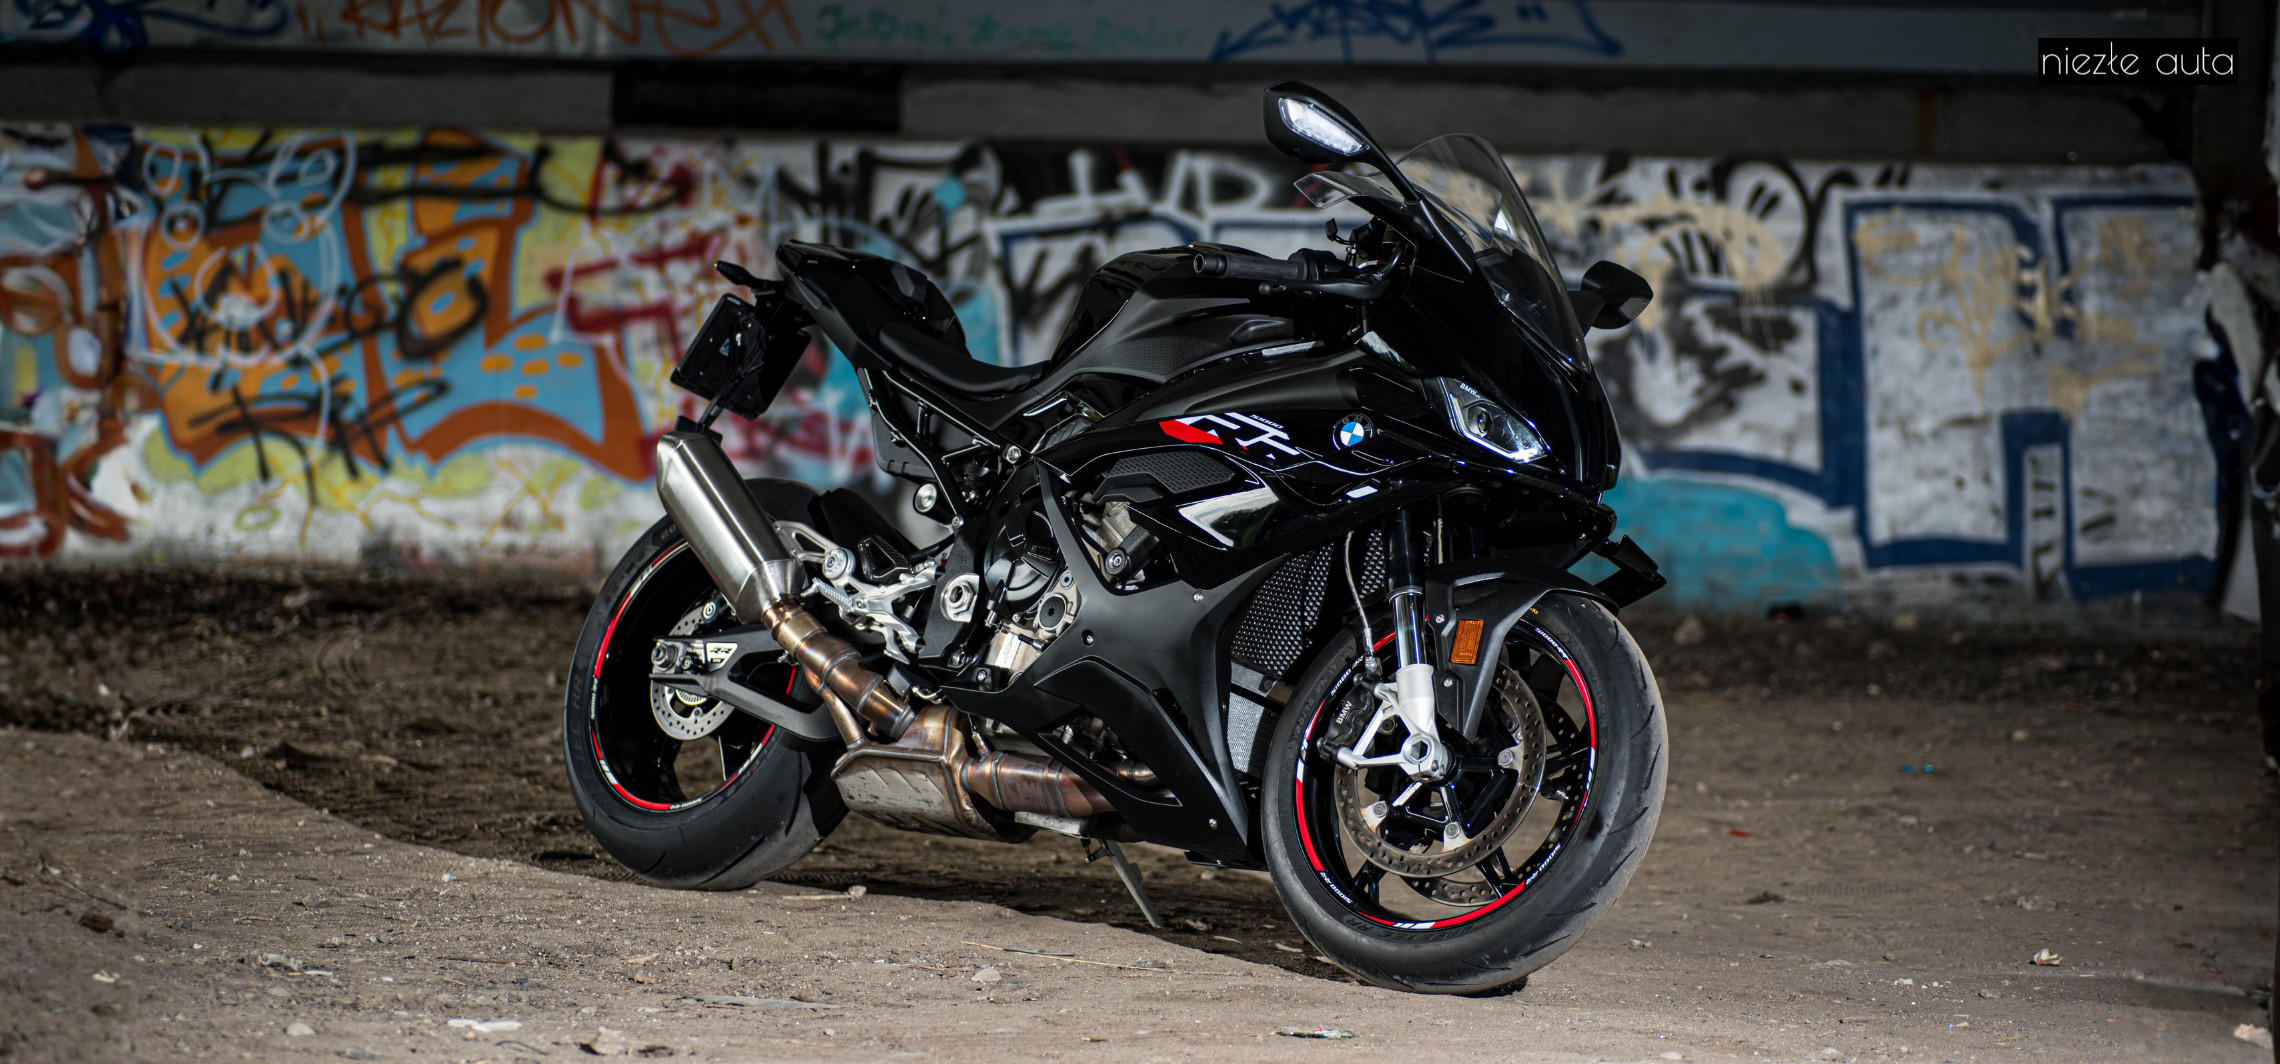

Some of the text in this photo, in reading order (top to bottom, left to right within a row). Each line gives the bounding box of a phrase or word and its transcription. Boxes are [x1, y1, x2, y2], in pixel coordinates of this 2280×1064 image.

[1459, 382, 1477, 396] BMW
[1250, 414, 1284, 429] S1000
[1534, 627, 1557, 647] S1000
[1330, 668, 1352, 697] S1000
[1336, 700, 1353, 724] BMW
[1329, 883, 1353, 904] S1000
